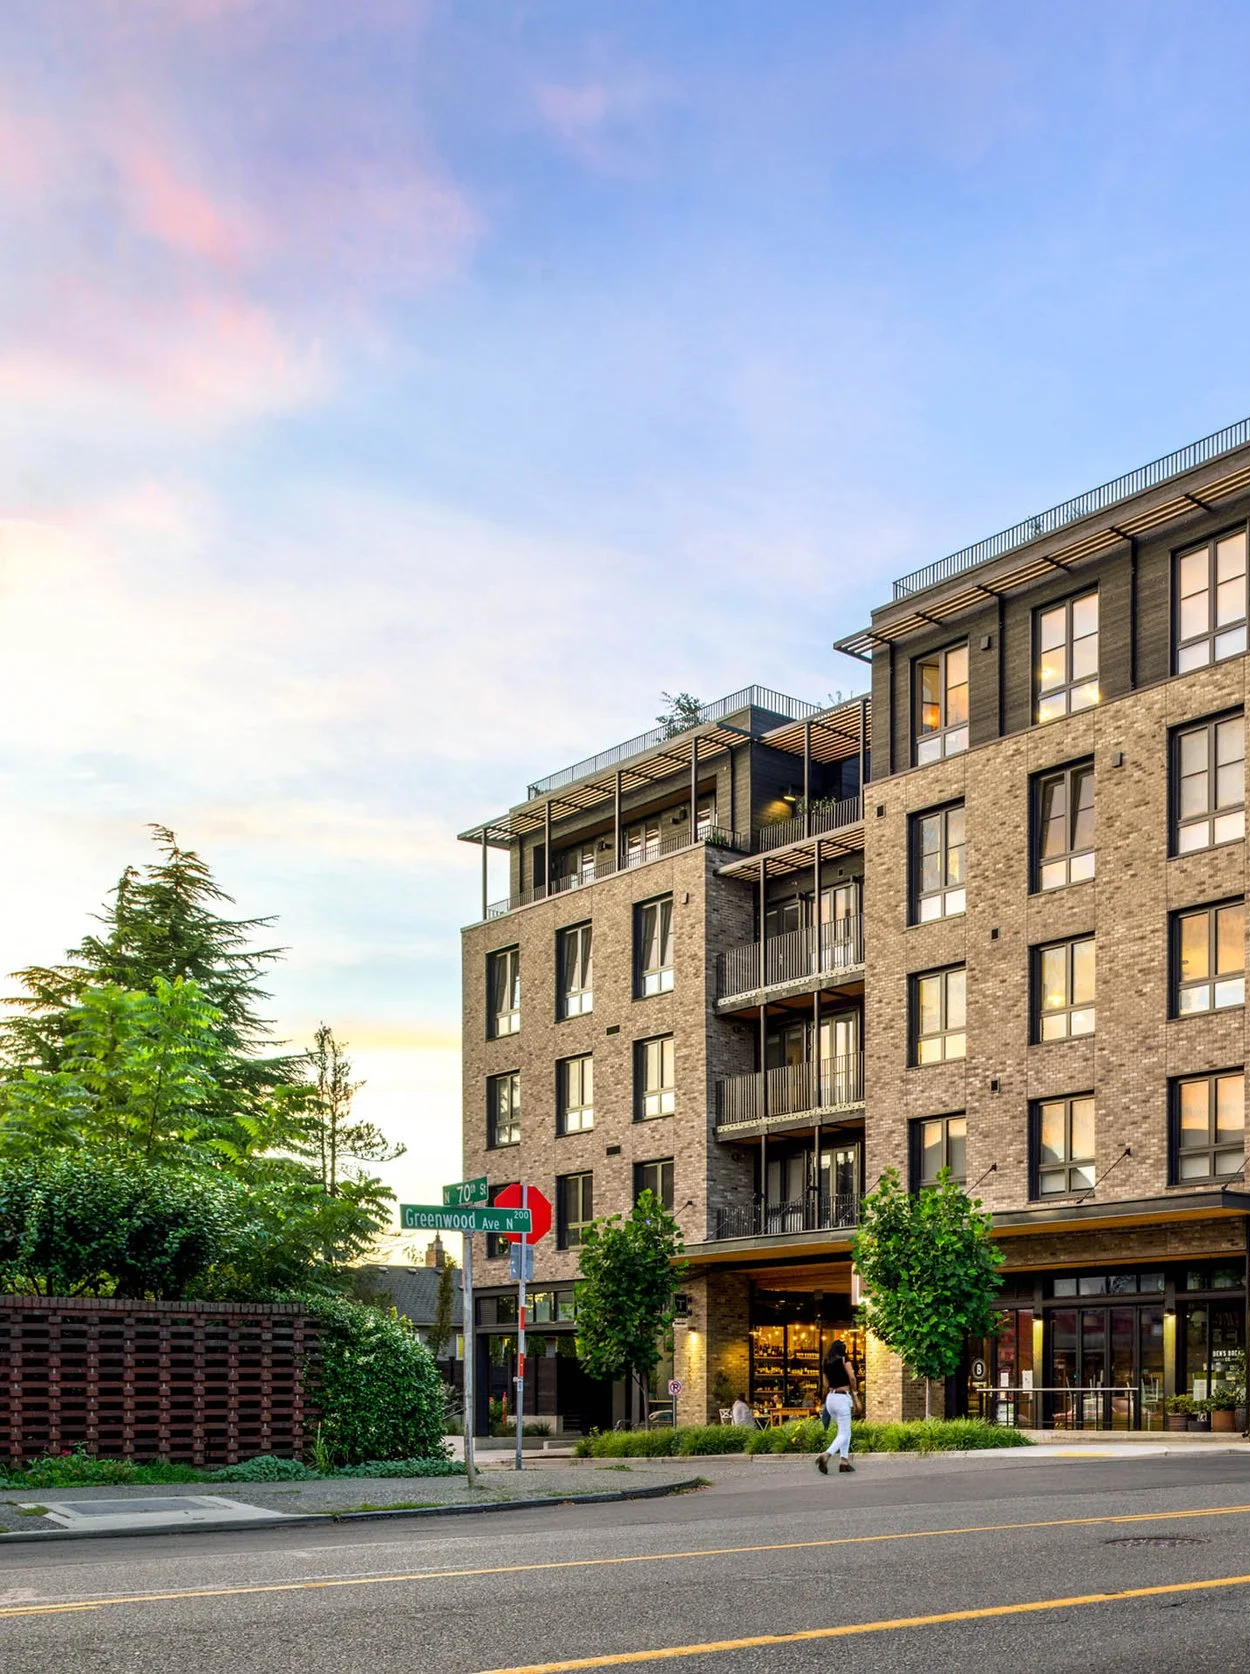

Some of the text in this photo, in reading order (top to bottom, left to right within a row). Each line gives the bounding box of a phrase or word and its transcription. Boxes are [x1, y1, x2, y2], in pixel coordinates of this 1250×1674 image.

[444, 1183, 487, 1204] N 70th St
[405, 1208, 529, 1230] Greenwood Ave N 200
[976, 1363, 982, 1375] B
